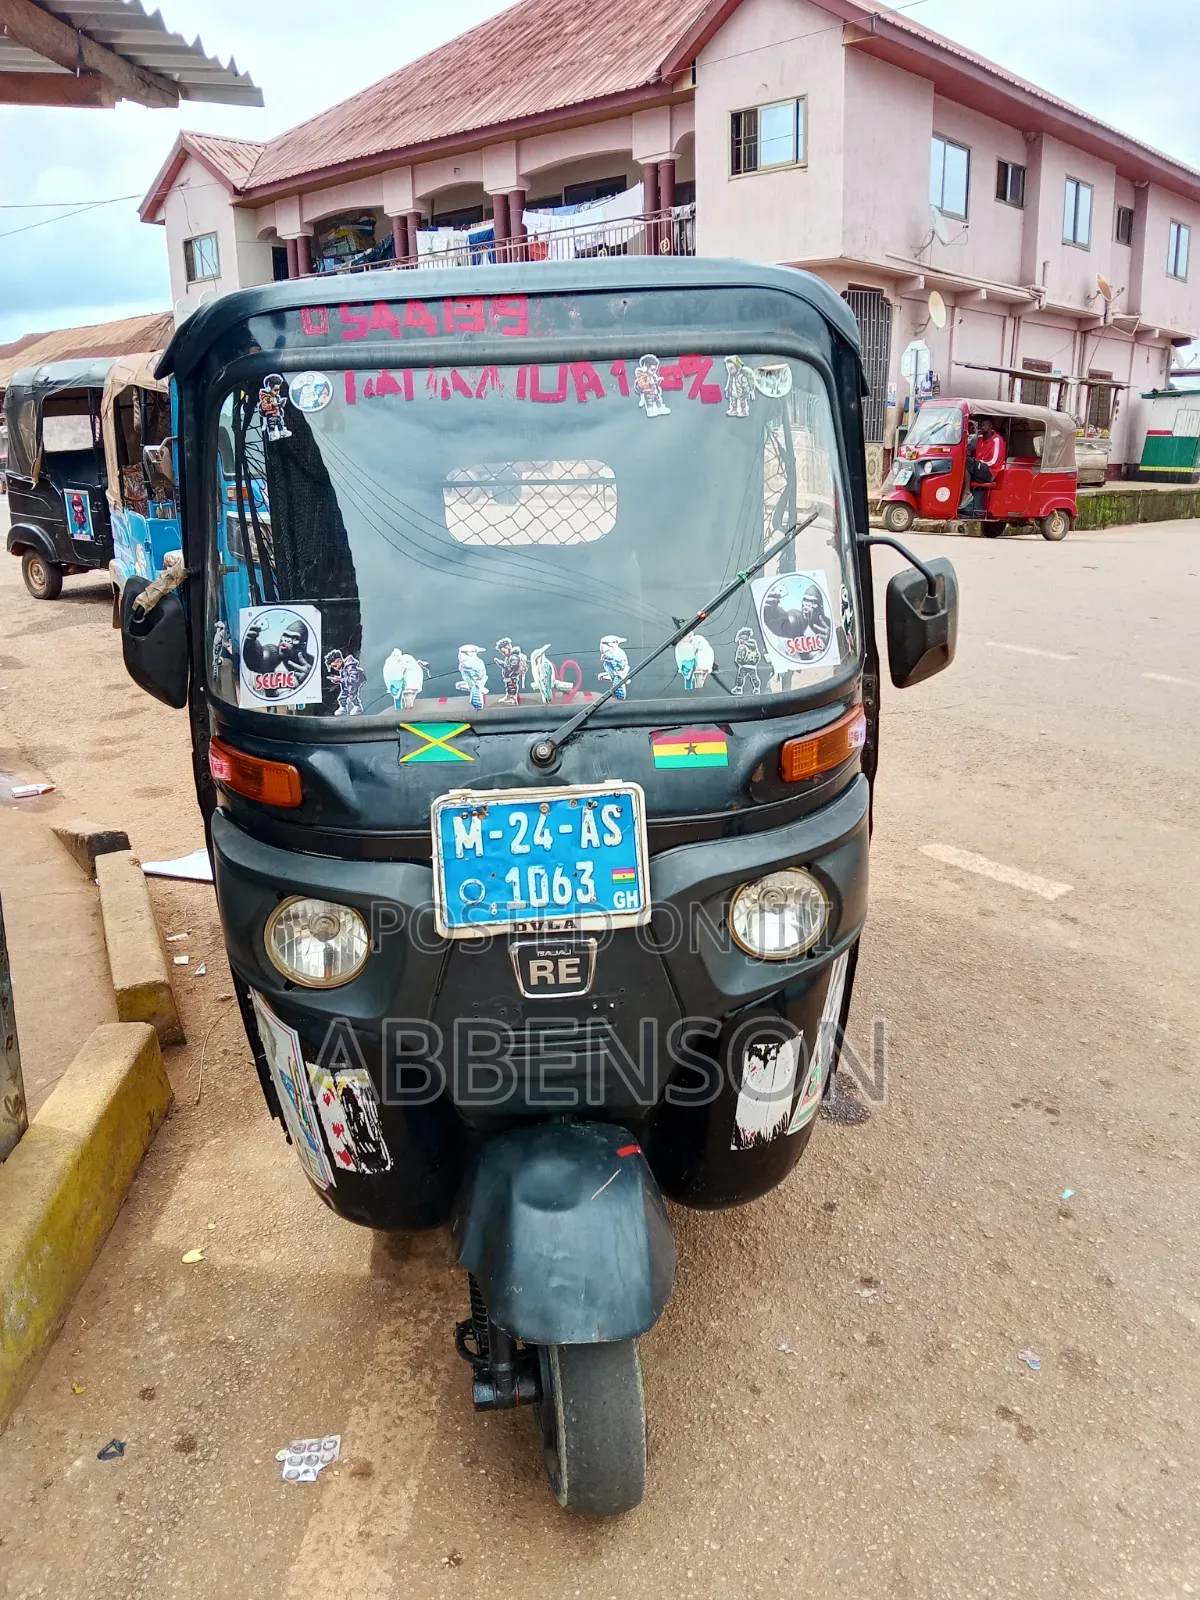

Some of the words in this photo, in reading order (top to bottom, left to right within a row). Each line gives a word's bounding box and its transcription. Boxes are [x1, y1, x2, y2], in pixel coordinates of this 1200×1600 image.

[785, 633, 824, 655] SELFIE
[255, 671, 296, 691] SELFIE
[505, 860, 595, 909] 1063
[613, 890, 638, 910] GH
[513, 919, 577, 933] DVLA
[537, 949, 572, 957] BAJAJ
[529, 958, 581, 986] RE
